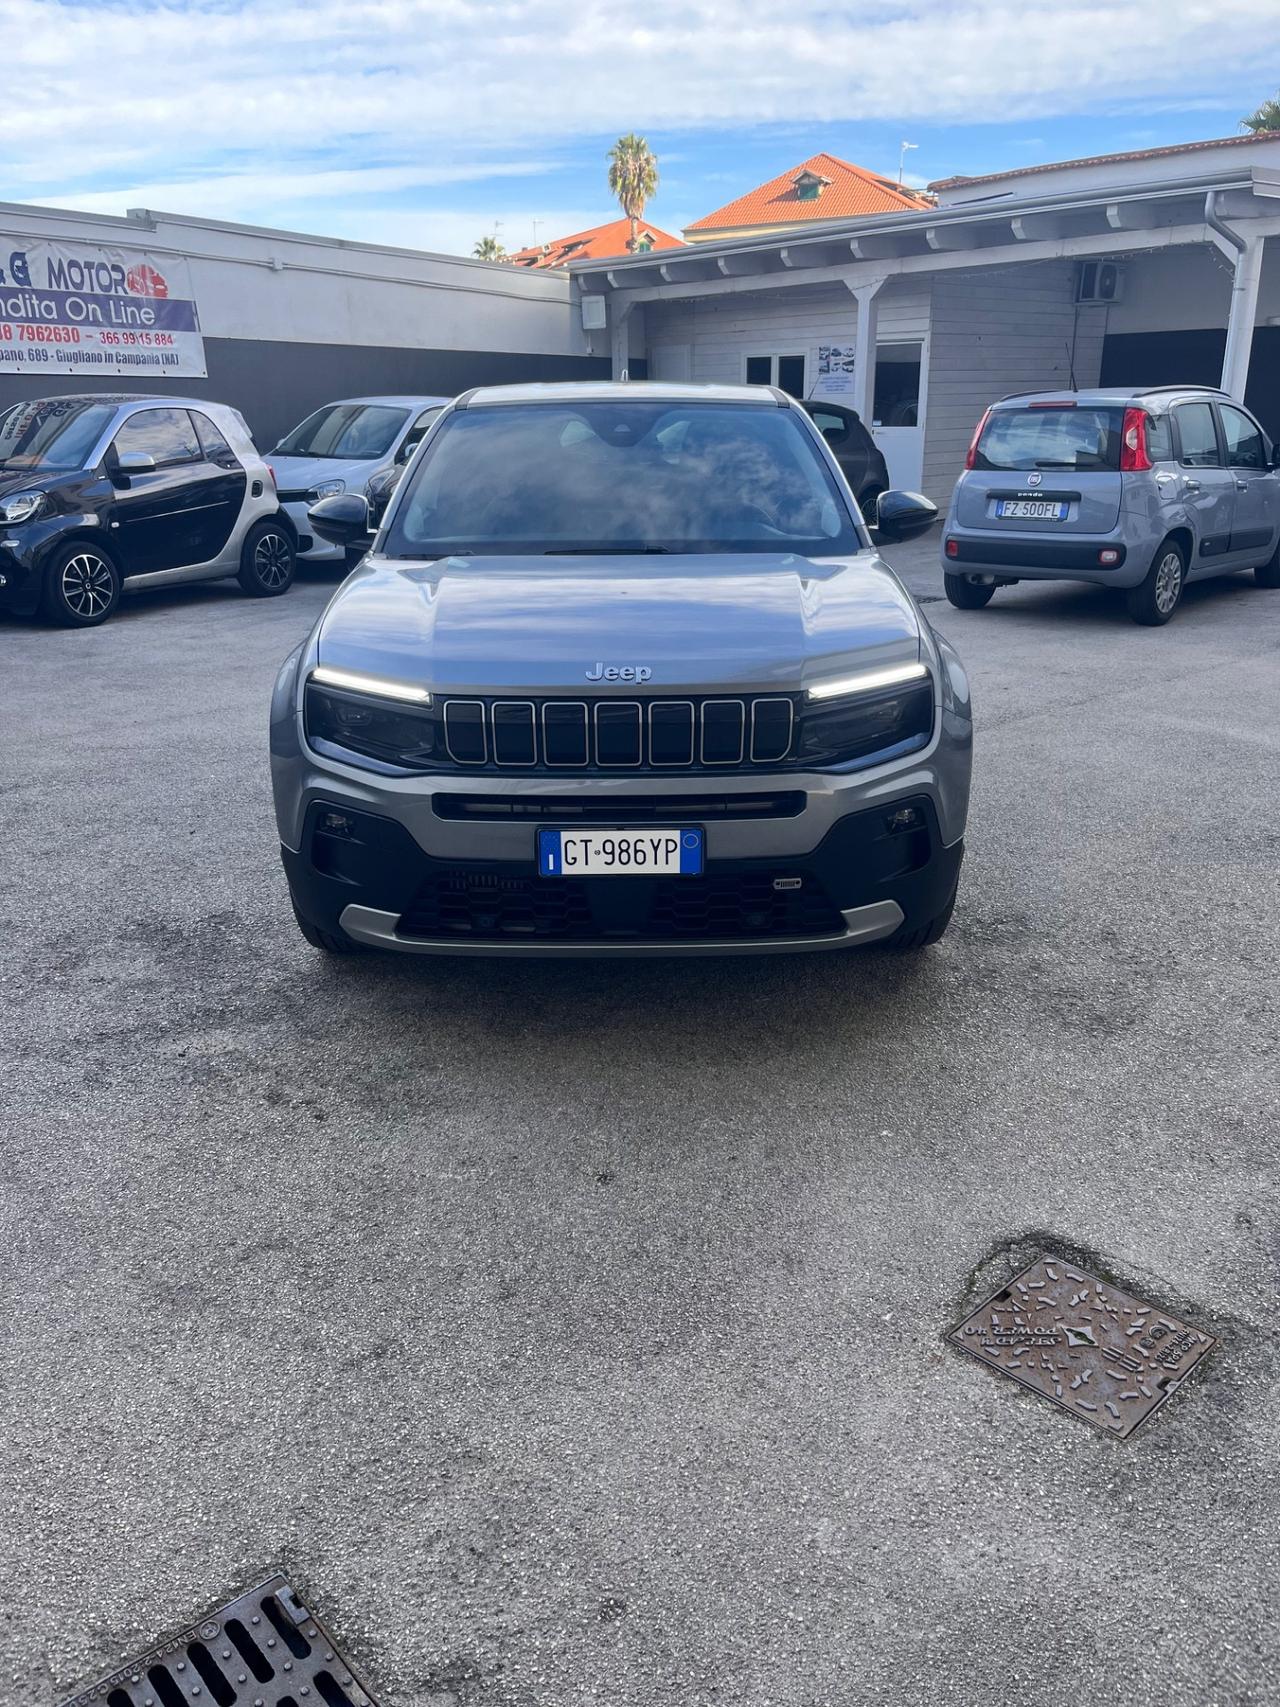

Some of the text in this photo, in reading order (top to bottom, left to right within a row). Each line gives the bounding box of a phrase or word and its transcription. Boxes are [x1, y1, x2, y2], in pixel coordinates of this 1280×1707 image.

[66, 297, 103, 322] On
[110, 300, 156, 326] Line
[16, 324, 81, 344] 7962630
[99, 331, 120, 344] 366
[154, 333, 174, 346] 884
[28, 348, 49, 363] 689
[56, 349, 103, 364] Giugliano
[104, 351, 114, 364] in
[115, 352, 161, 366] Campania
[1003, 502, 1019, 516] FZ
[1022, 502, 1059, 518] 500FL
[585, 662, 652, 684] Jeep
[564, 839, 593, 866] GT
[602, 838, 678, 866] 986YP
